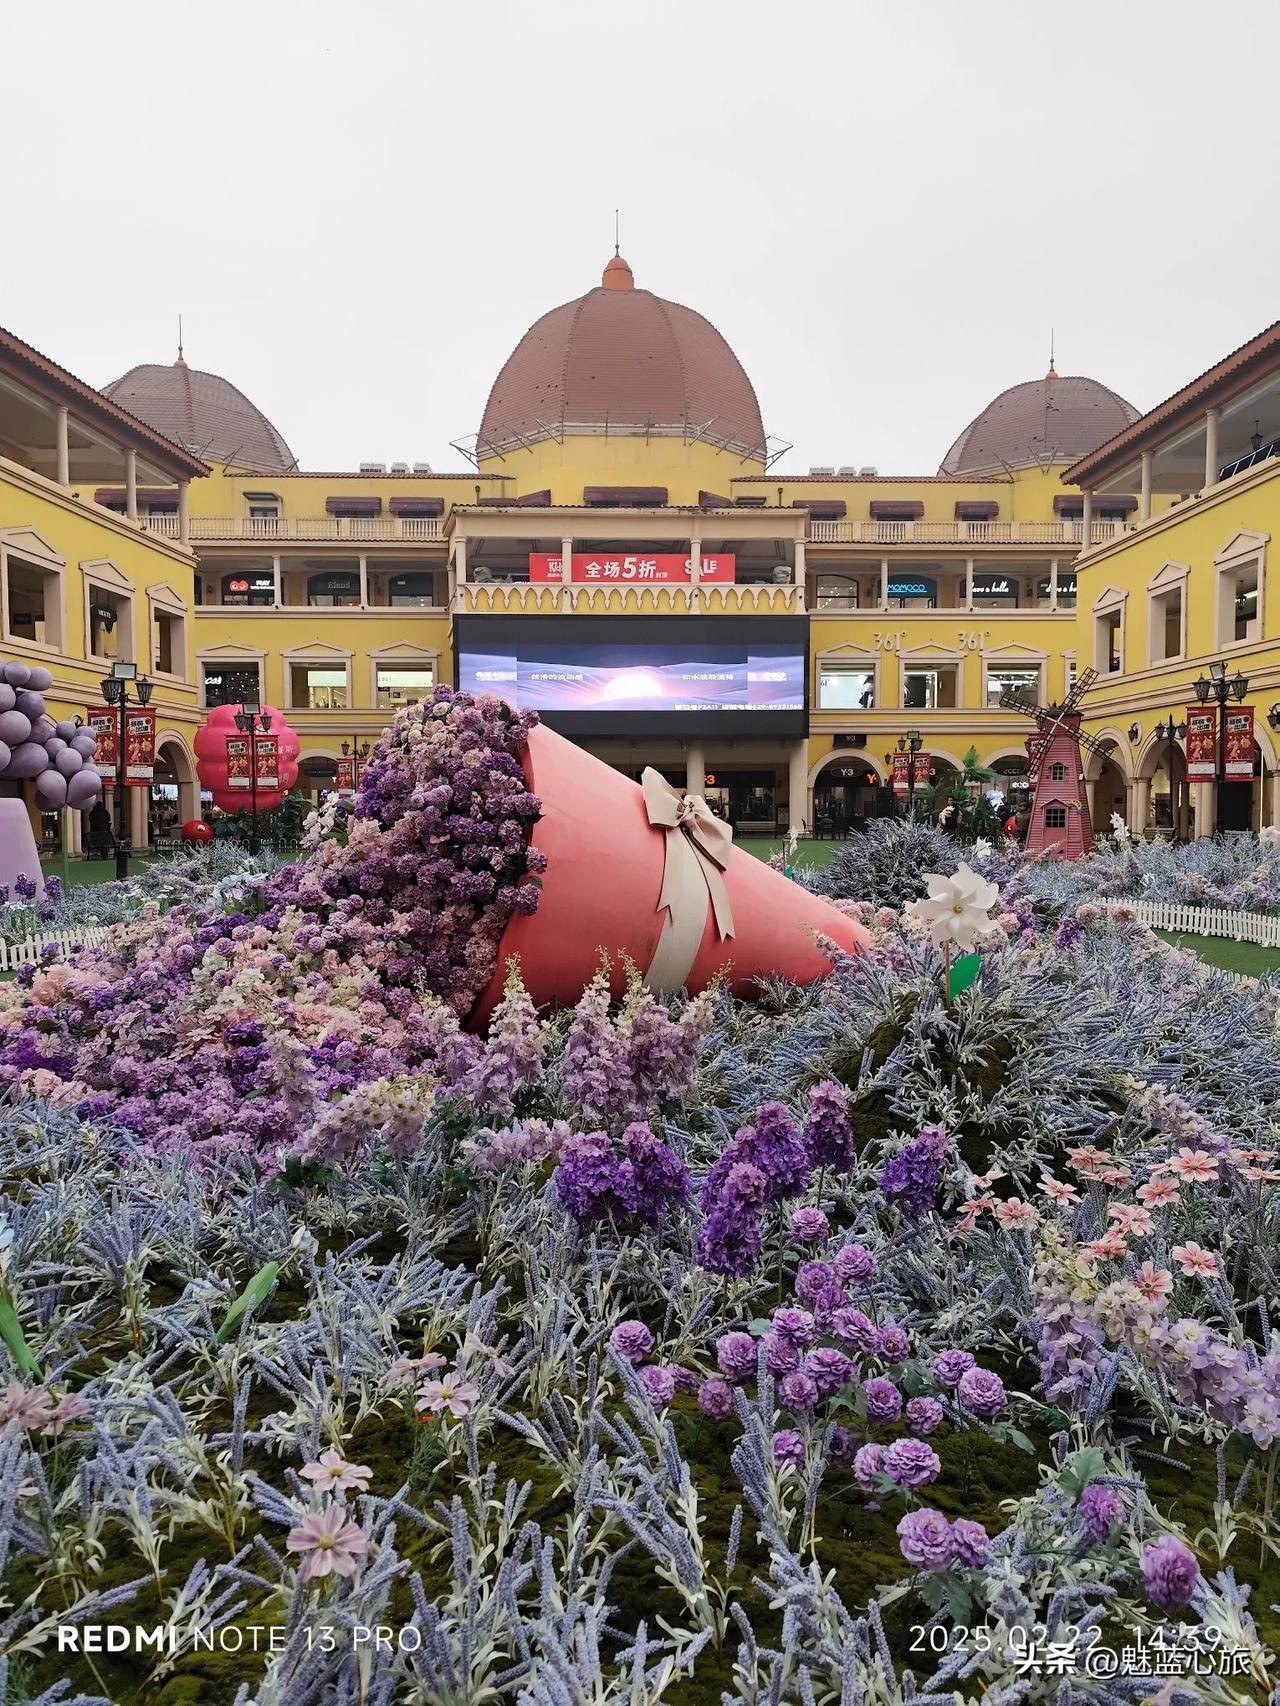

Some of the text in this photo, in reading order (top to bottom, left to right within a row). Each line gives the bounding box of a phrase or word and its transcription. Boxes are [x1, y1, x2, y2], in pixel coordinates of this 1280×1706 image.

[585, 557, 657, 578] 全场5折
[841, 768, 854, 776] Y-3
[704, 774, 716, 785] -3
[866, 773, 877, 784] Y-
